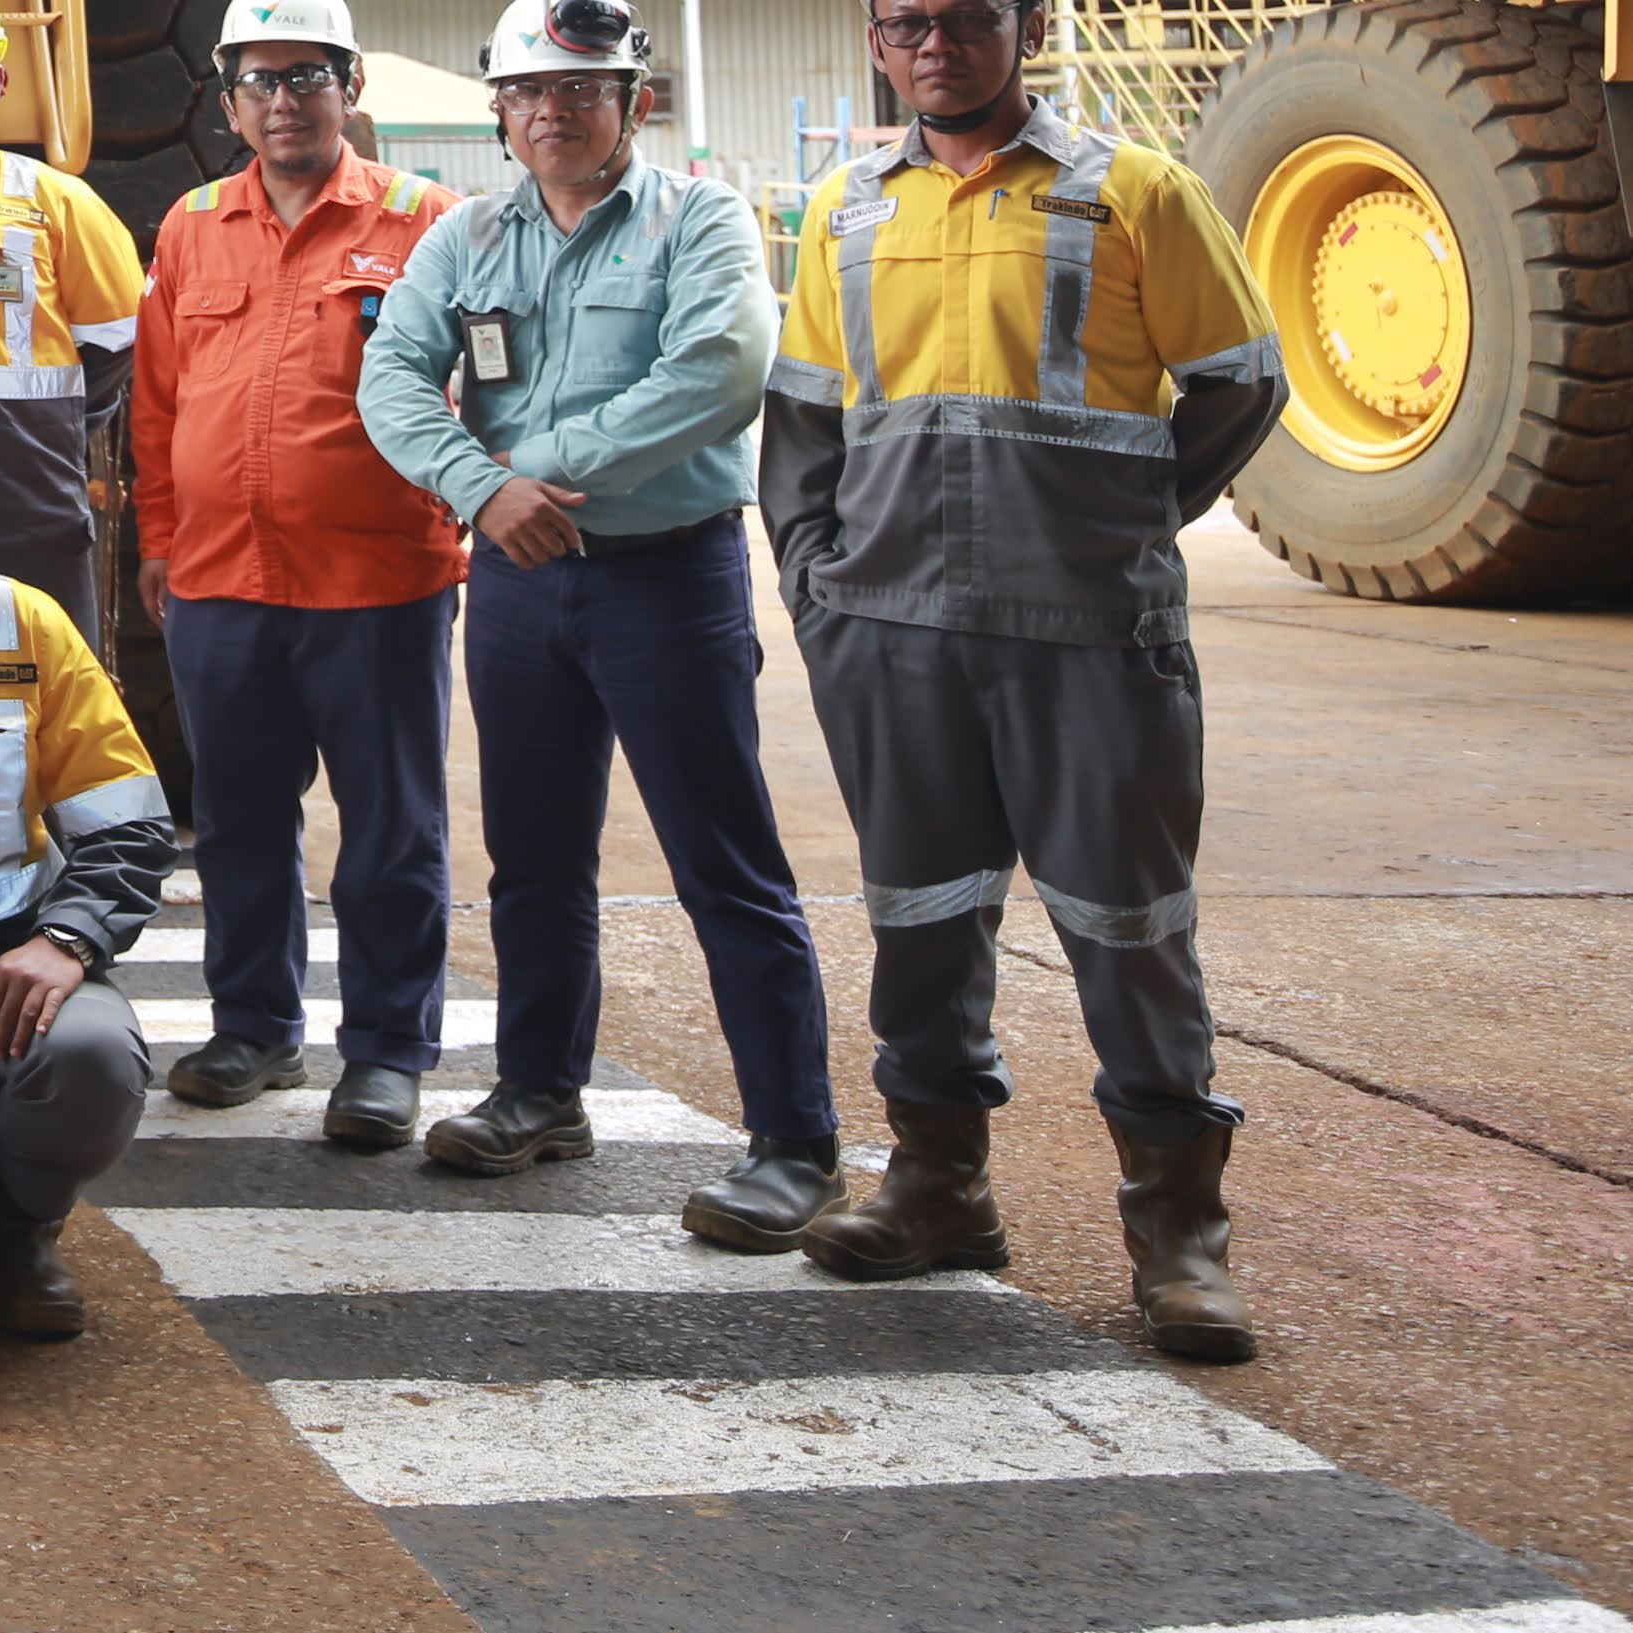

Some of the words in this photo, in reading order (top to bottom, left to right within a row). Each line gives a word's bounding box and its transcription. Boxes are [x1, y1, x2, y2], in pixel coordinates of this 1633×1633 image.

[274, 15, 306, 26] VALE
[837, 202, 890, 223] MARNUDDIN
[1041, 199, 1086, 216] Trakindo
[371, 262, 397, 275] VALE
